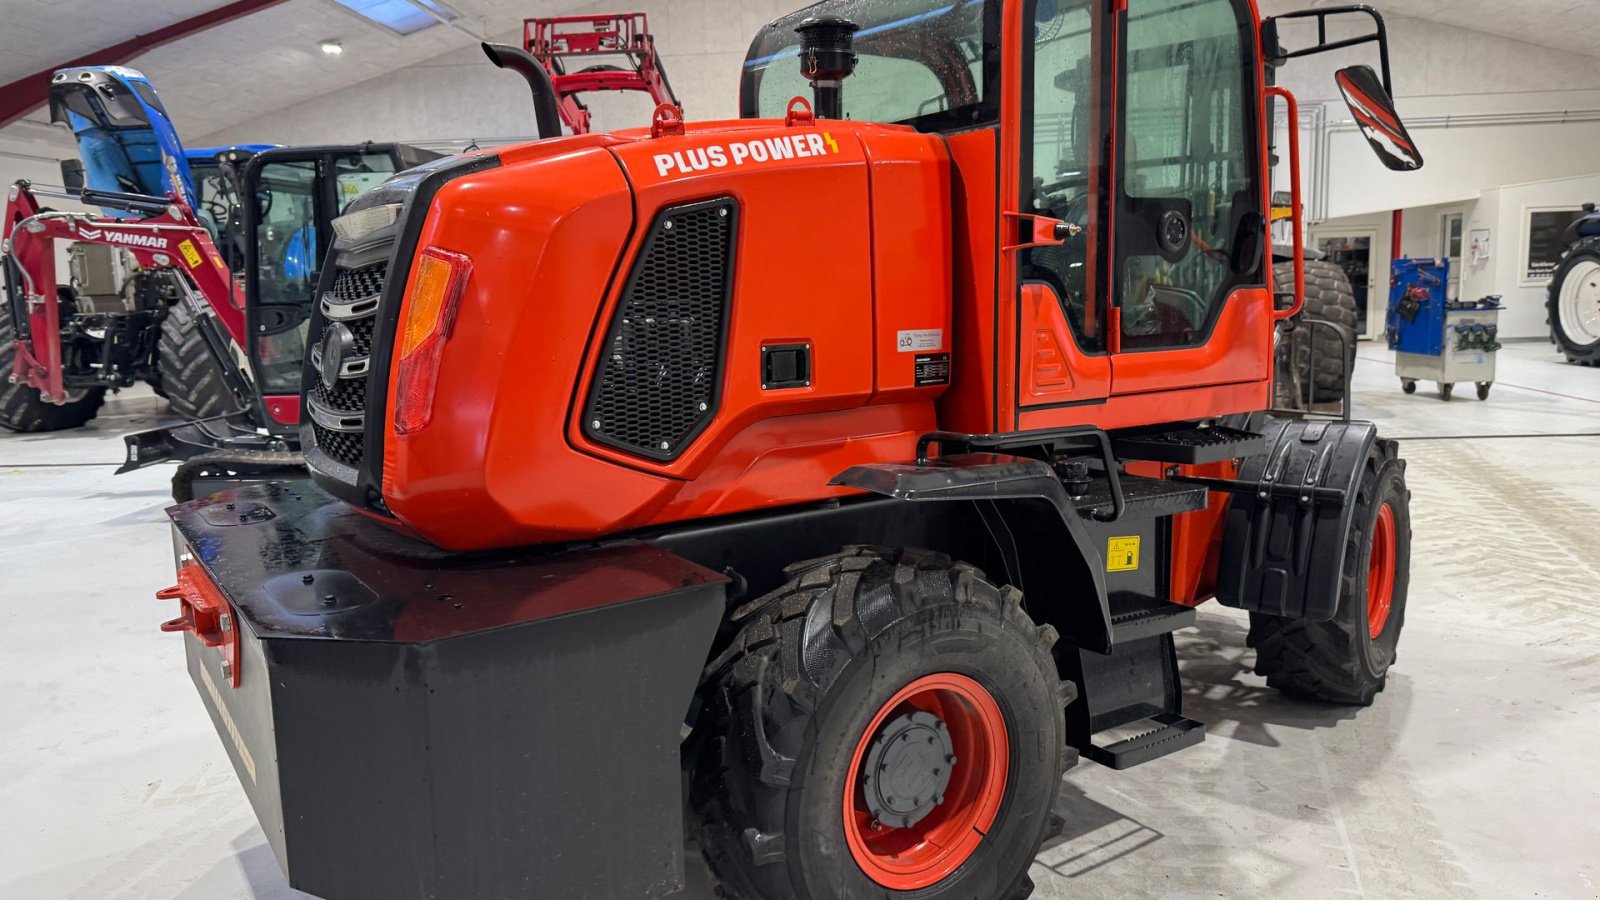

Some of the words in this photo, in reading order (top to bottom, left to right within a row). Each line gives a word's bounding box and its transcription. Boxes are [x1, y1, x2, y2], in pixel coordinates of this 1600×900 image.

[653, 145, 728, 177] PLUS
[729, 133, 827, 165] POWER
[104, 231, 168, 248] YANMAR
